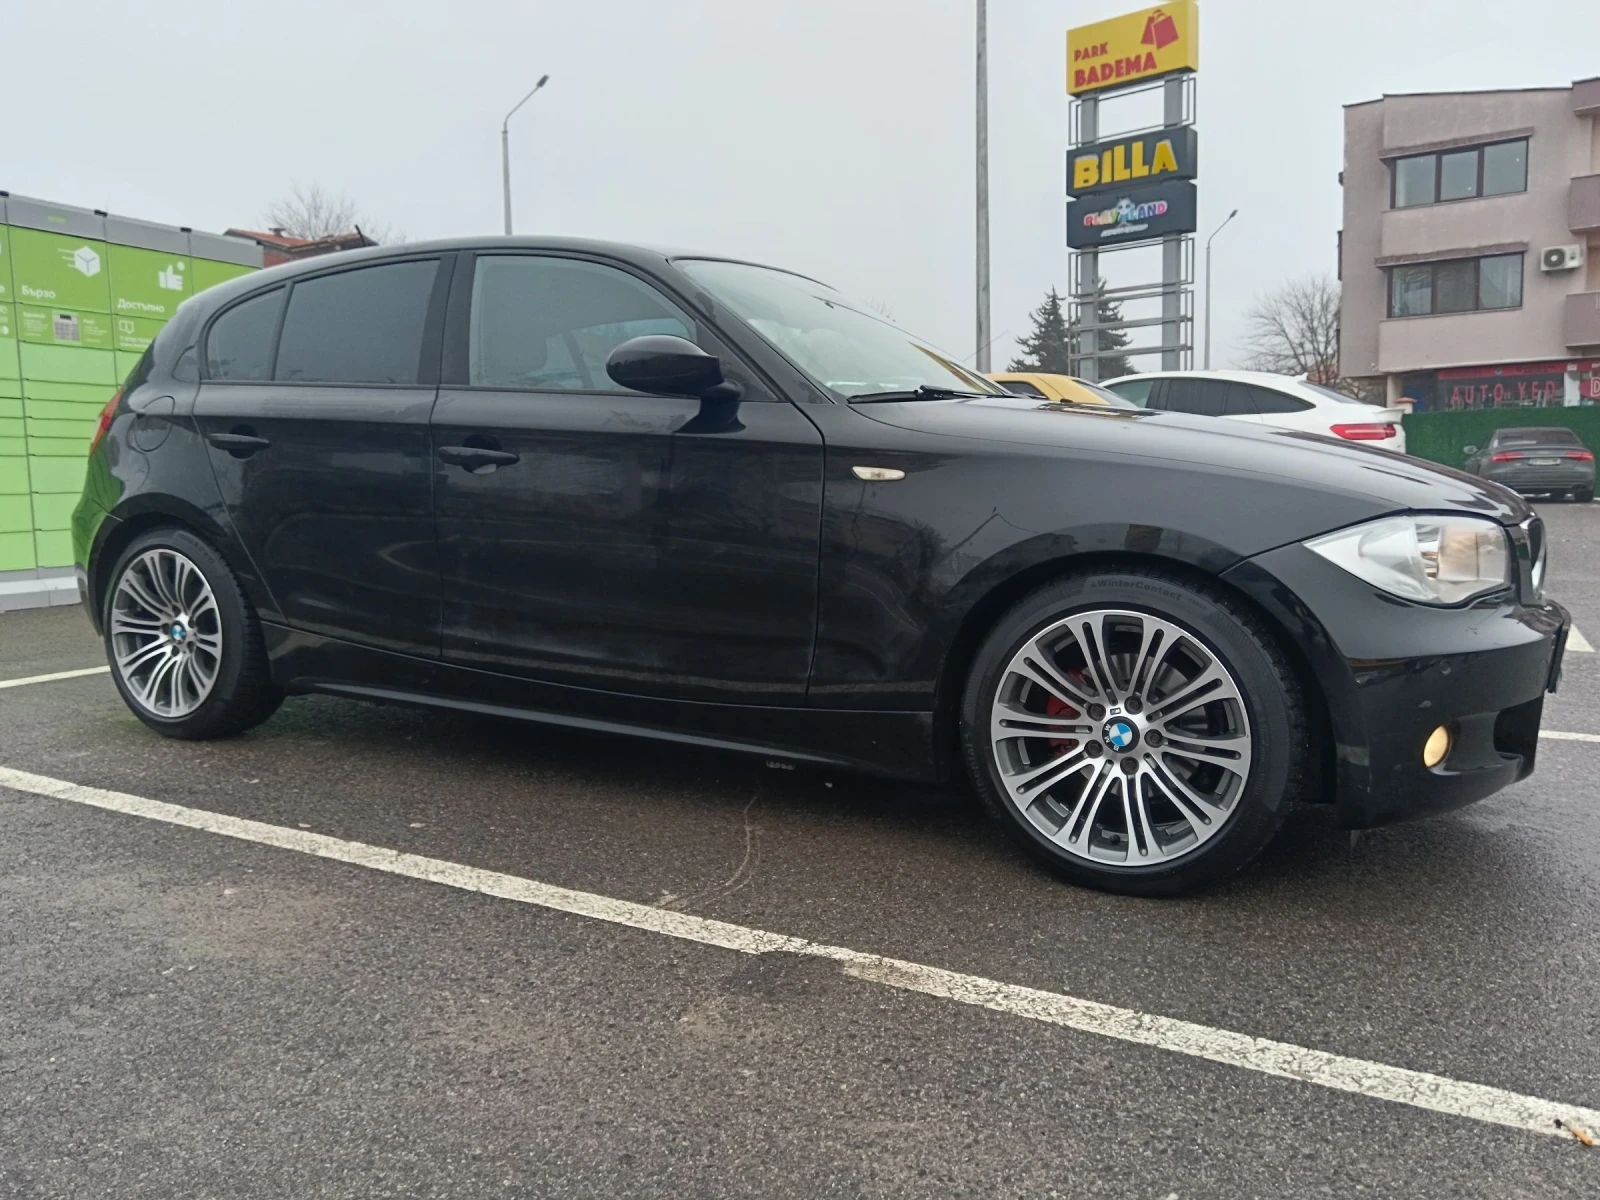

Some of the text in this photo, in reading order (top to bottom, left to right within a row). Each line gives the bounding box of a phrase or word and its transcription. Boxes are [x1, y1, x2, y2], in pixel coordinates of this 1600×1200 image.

[1074, 41, 1108, 62] PARK
[1074, 51, 1157, 89] BADEMA
[1073, 138, 1178, 189] BILLA
[22, 284, 56, 299] Бързо
[117, 298, 165, 313] Достъпно
[1451, 383, 1504, 405] AUTO
[1097, 578, 1181, 601] WinterContact
